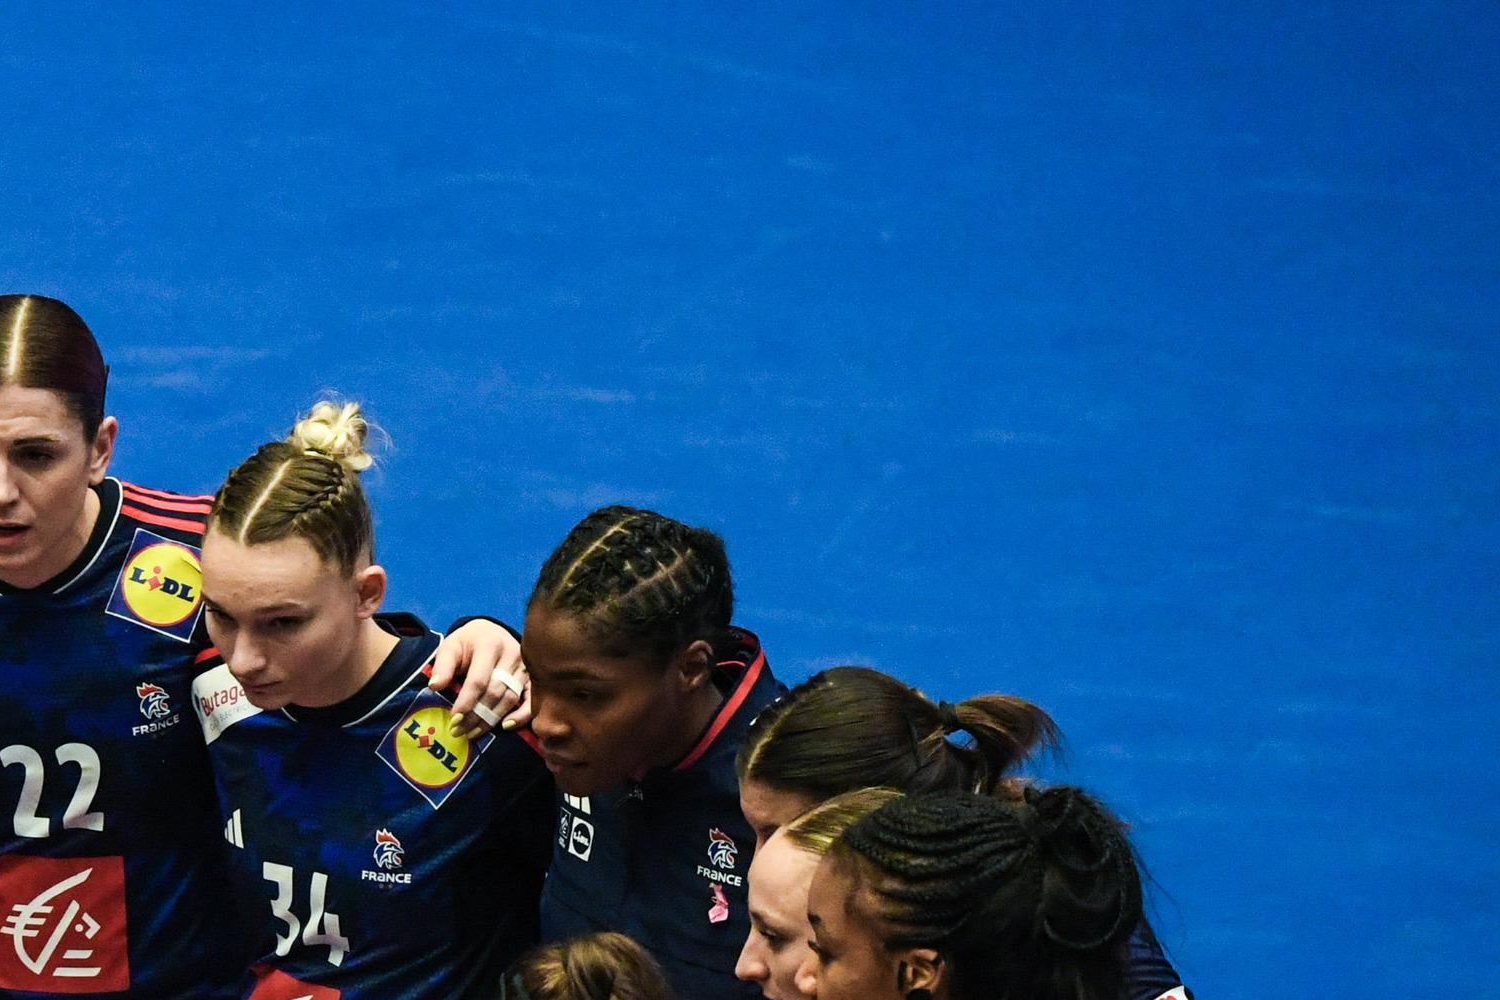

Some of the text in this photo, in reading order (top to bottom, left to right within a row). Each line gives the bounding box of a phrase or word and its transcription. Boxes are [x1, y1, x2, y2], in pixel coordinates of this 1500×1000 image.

[132, 713, 181, 737] FRANCE
[0, 742, 105, 838] 22
[361, 869, 412, 884] FRANCE
[696, 865, 743, 887] FRANCE
[262, 861, 350, 968] 34
